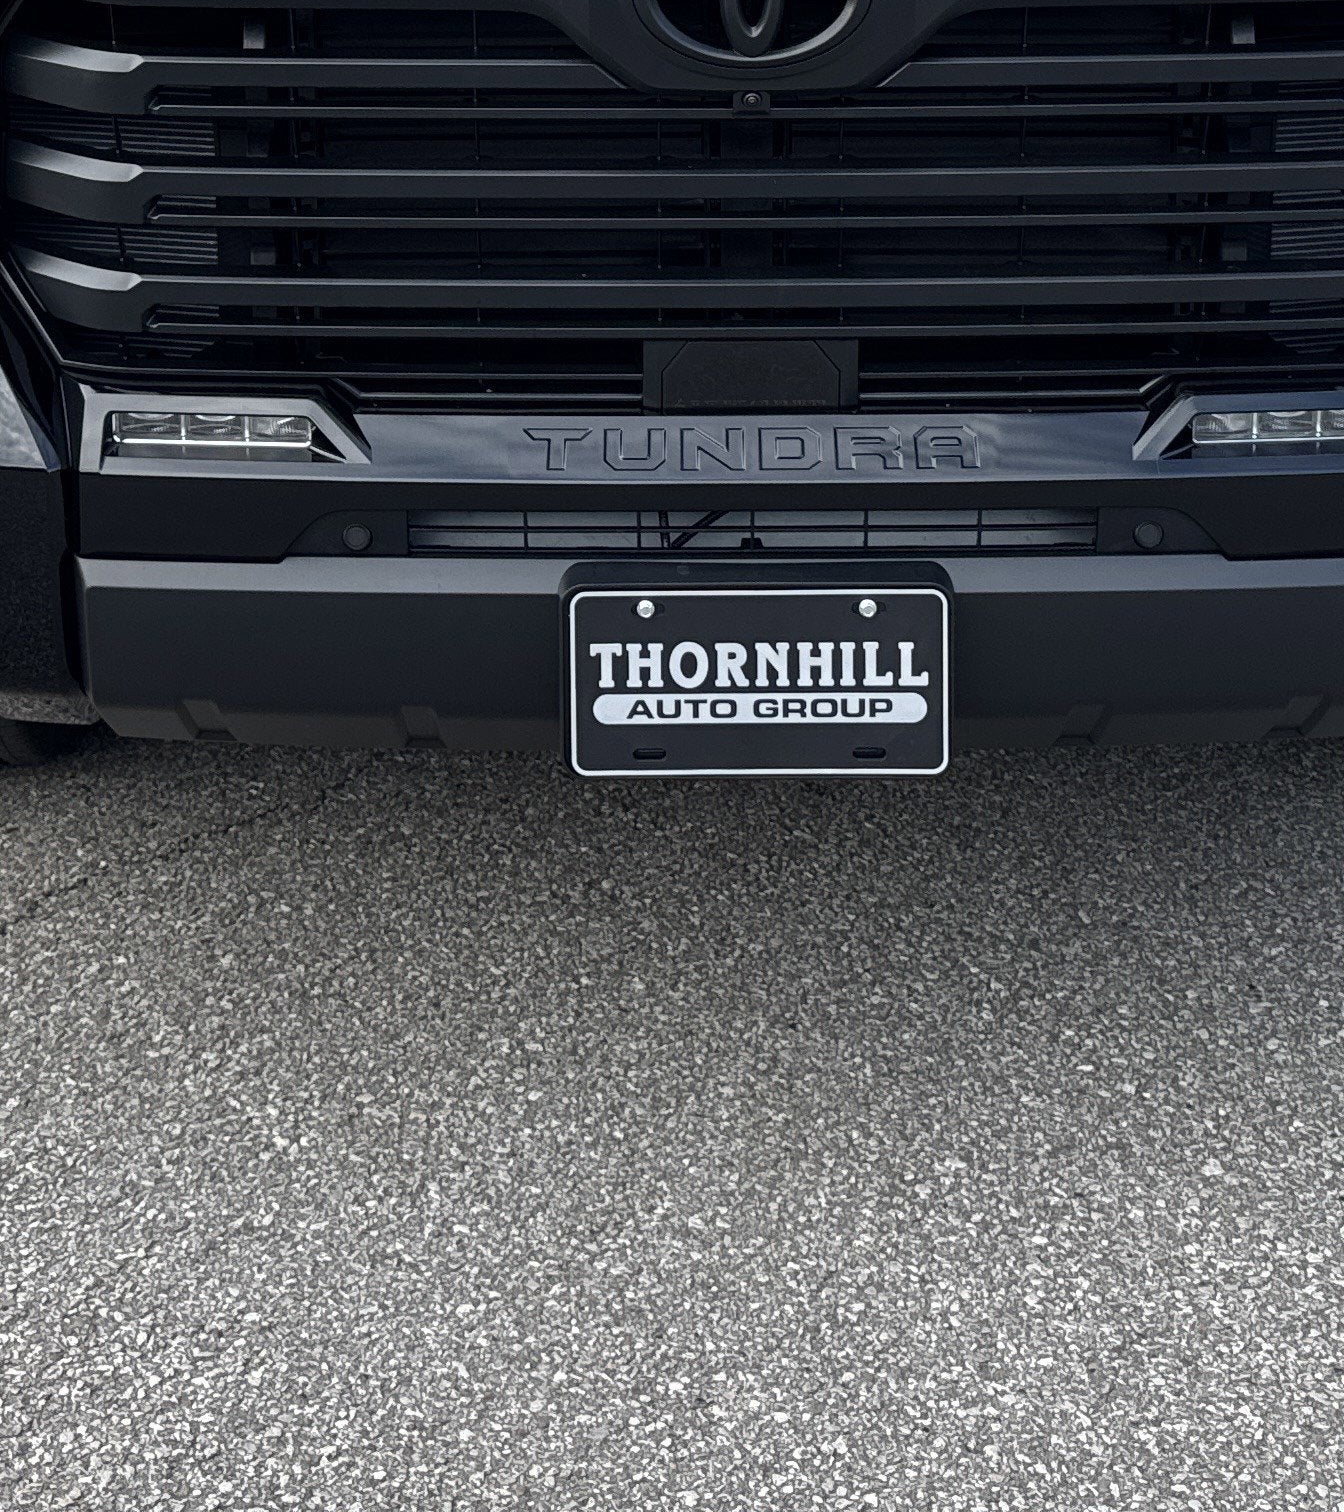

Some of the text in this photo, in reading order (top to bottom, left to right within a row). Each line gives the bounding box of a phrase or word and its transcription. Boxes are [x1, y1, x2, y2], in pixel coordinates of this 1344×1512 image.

[522, 425, 981, 472] TUNDRA
[589, 641, 930, 689] THORNHILL
[626, 698, 894, 720] AUTO GROUP
